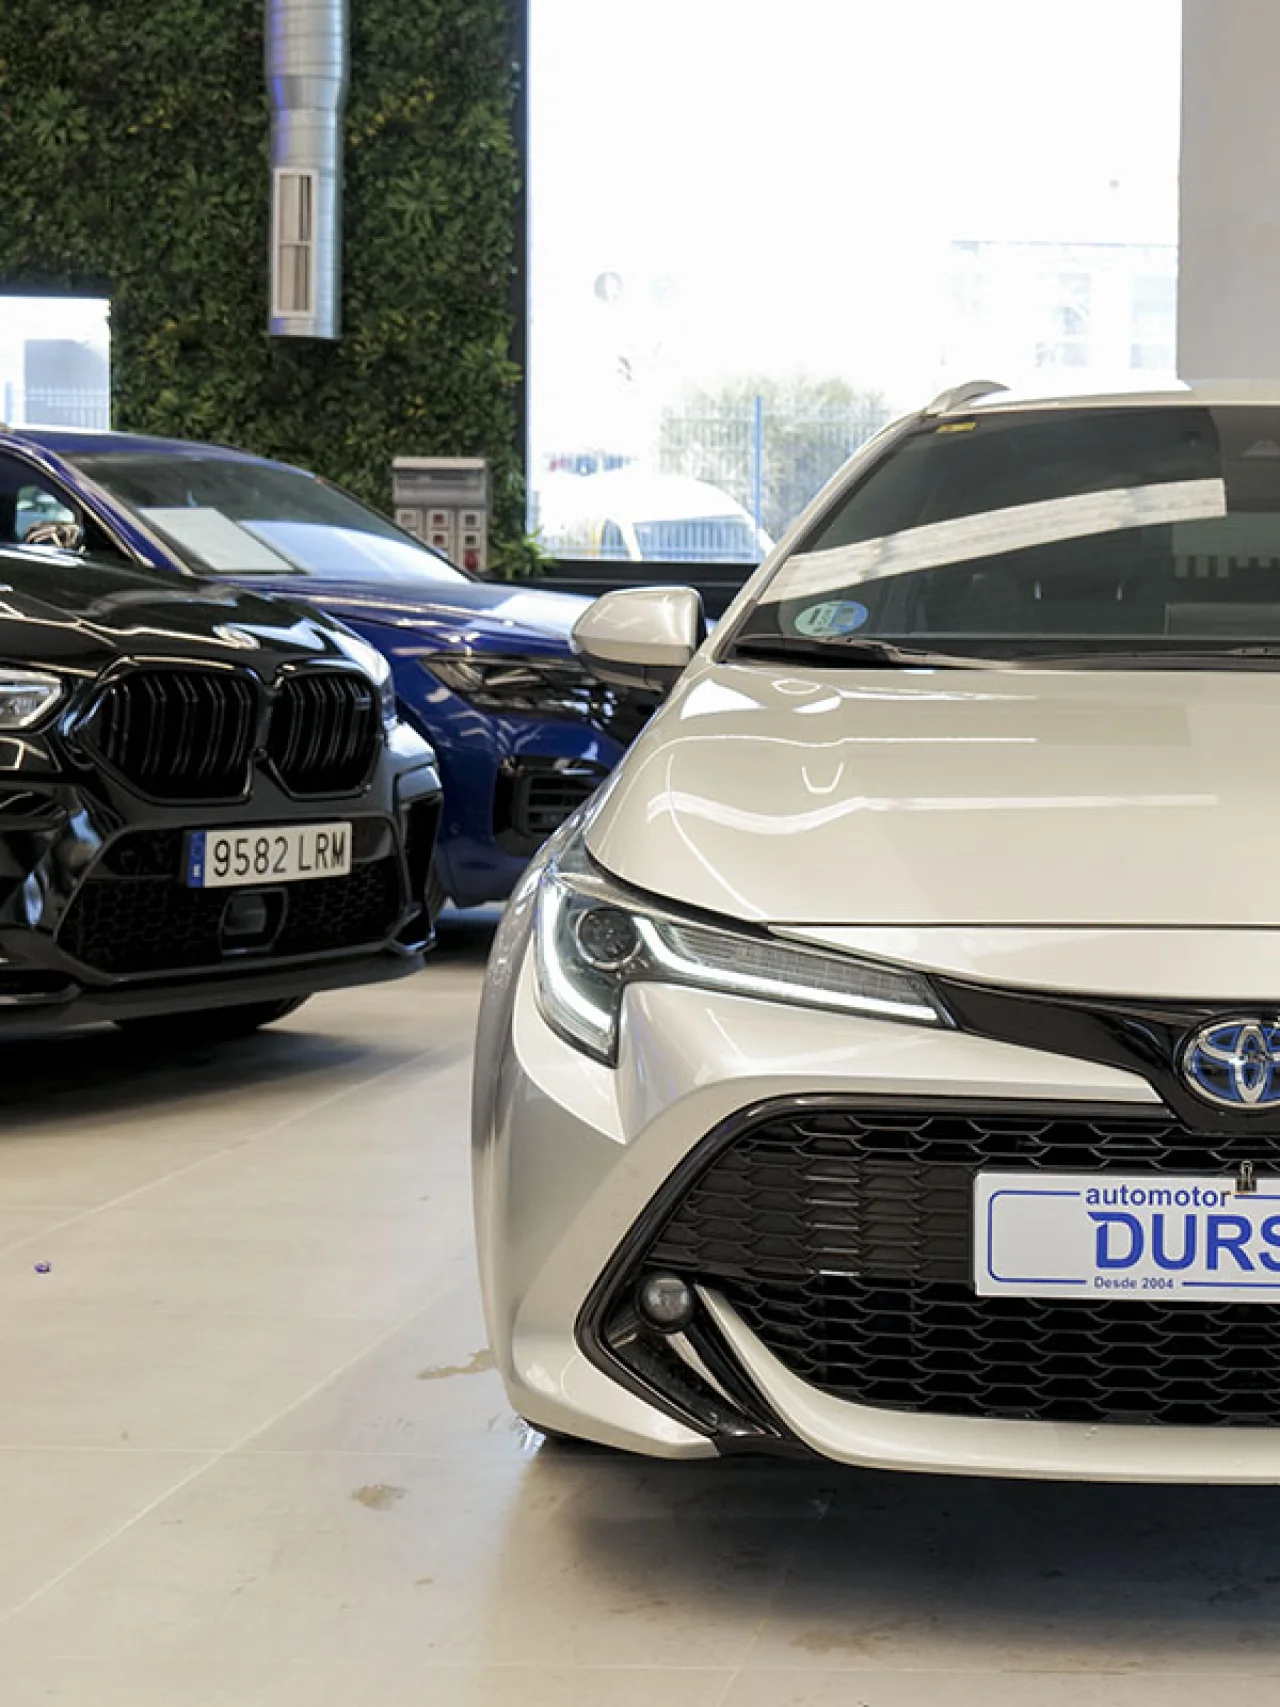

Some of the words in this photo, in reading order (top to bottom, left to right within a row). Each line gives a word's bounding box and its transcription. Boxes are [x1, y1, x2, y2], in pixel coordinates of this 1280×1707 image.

[213, 836, 289, 877] 9582
[298, 831, 345, 871] LRM
[1085, 1185, 1231, 1207] automotor
[1094, 1276, 1137, 1290] Desde
[1141, 1277, 1174, 1290] 2004
